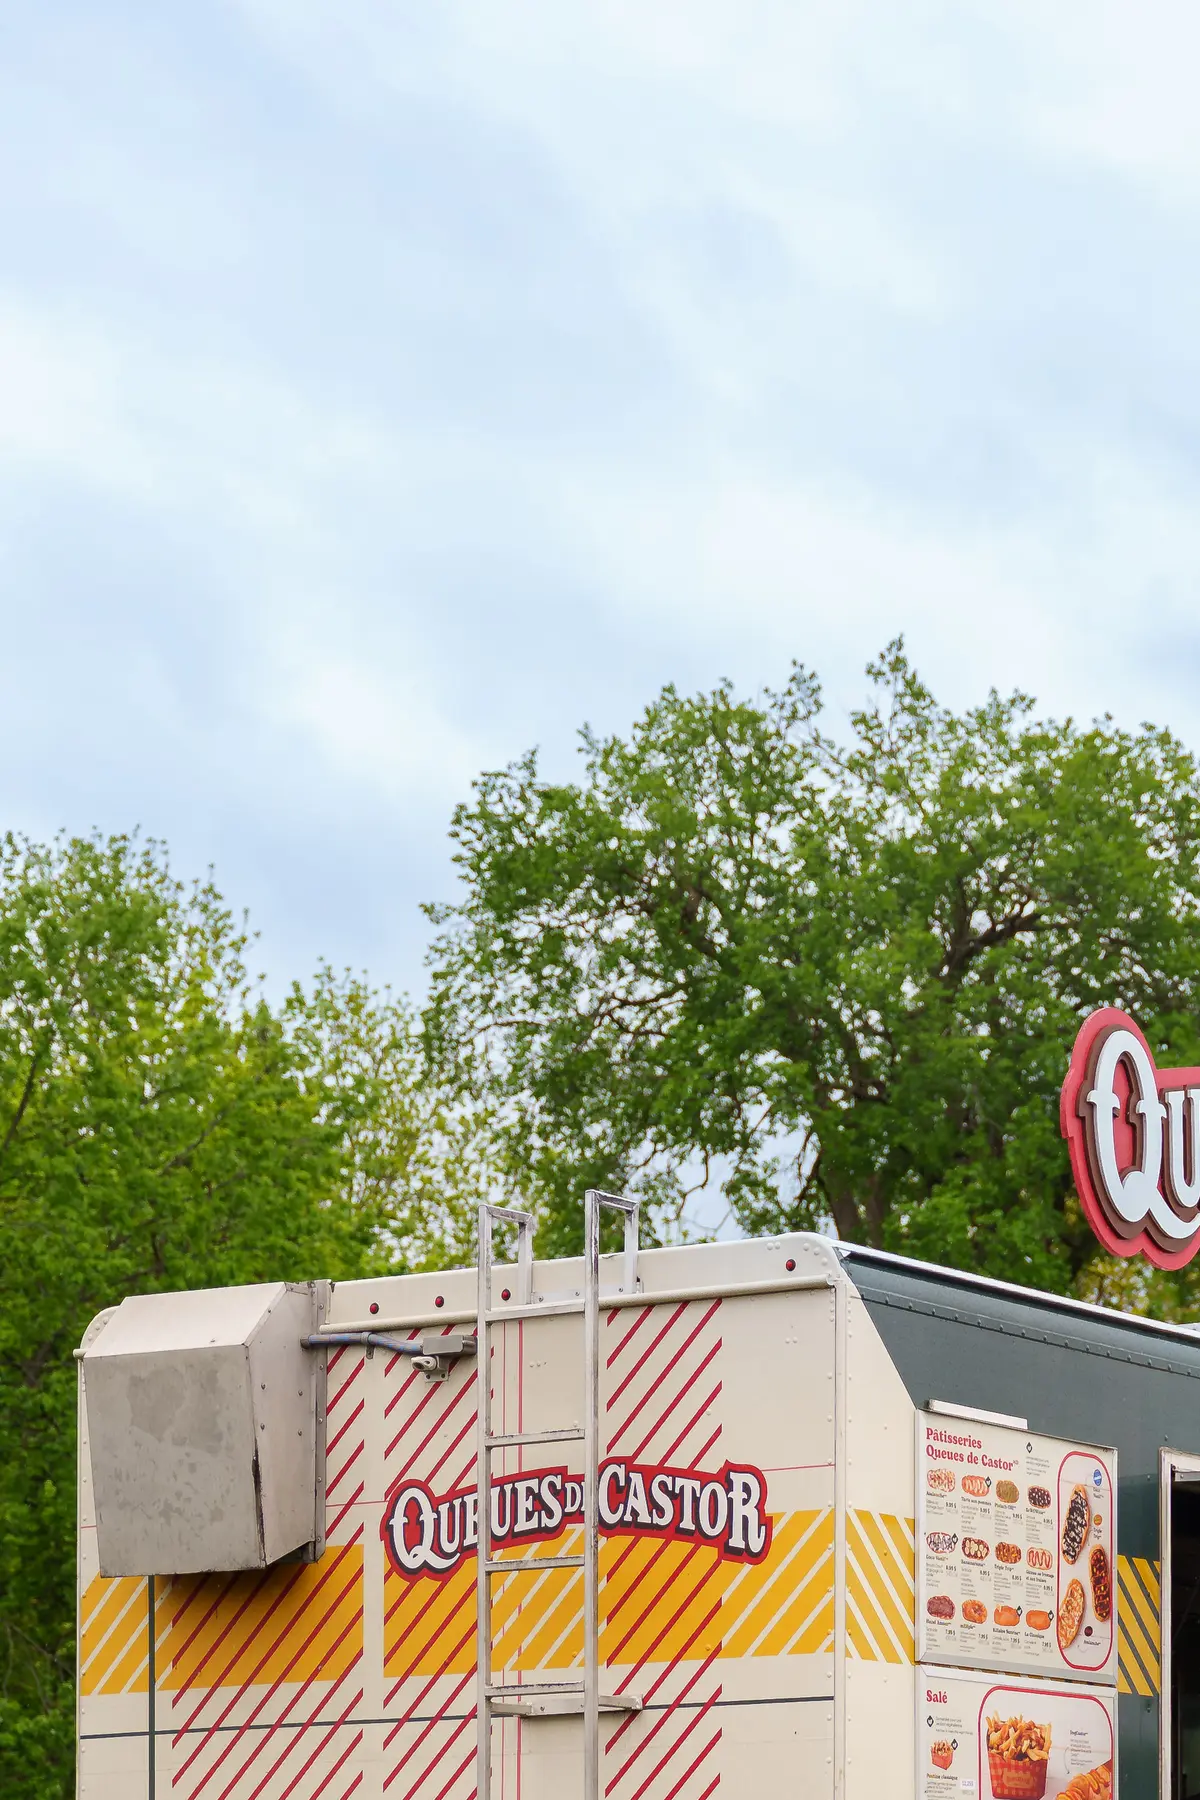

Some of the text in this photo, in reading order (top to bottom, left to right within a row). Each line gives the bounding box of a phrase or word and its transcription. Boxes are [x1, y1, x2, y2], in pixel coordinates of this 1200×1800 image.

[926, 1427, 982, 1449] Pâtisseries
[926, 1444, 965, 1462] Queues
[967, 1452, 979, 1465] de
[598, 1464, 766, 1553] CASTOR
[926, 1689, 948, 1704] Salé
